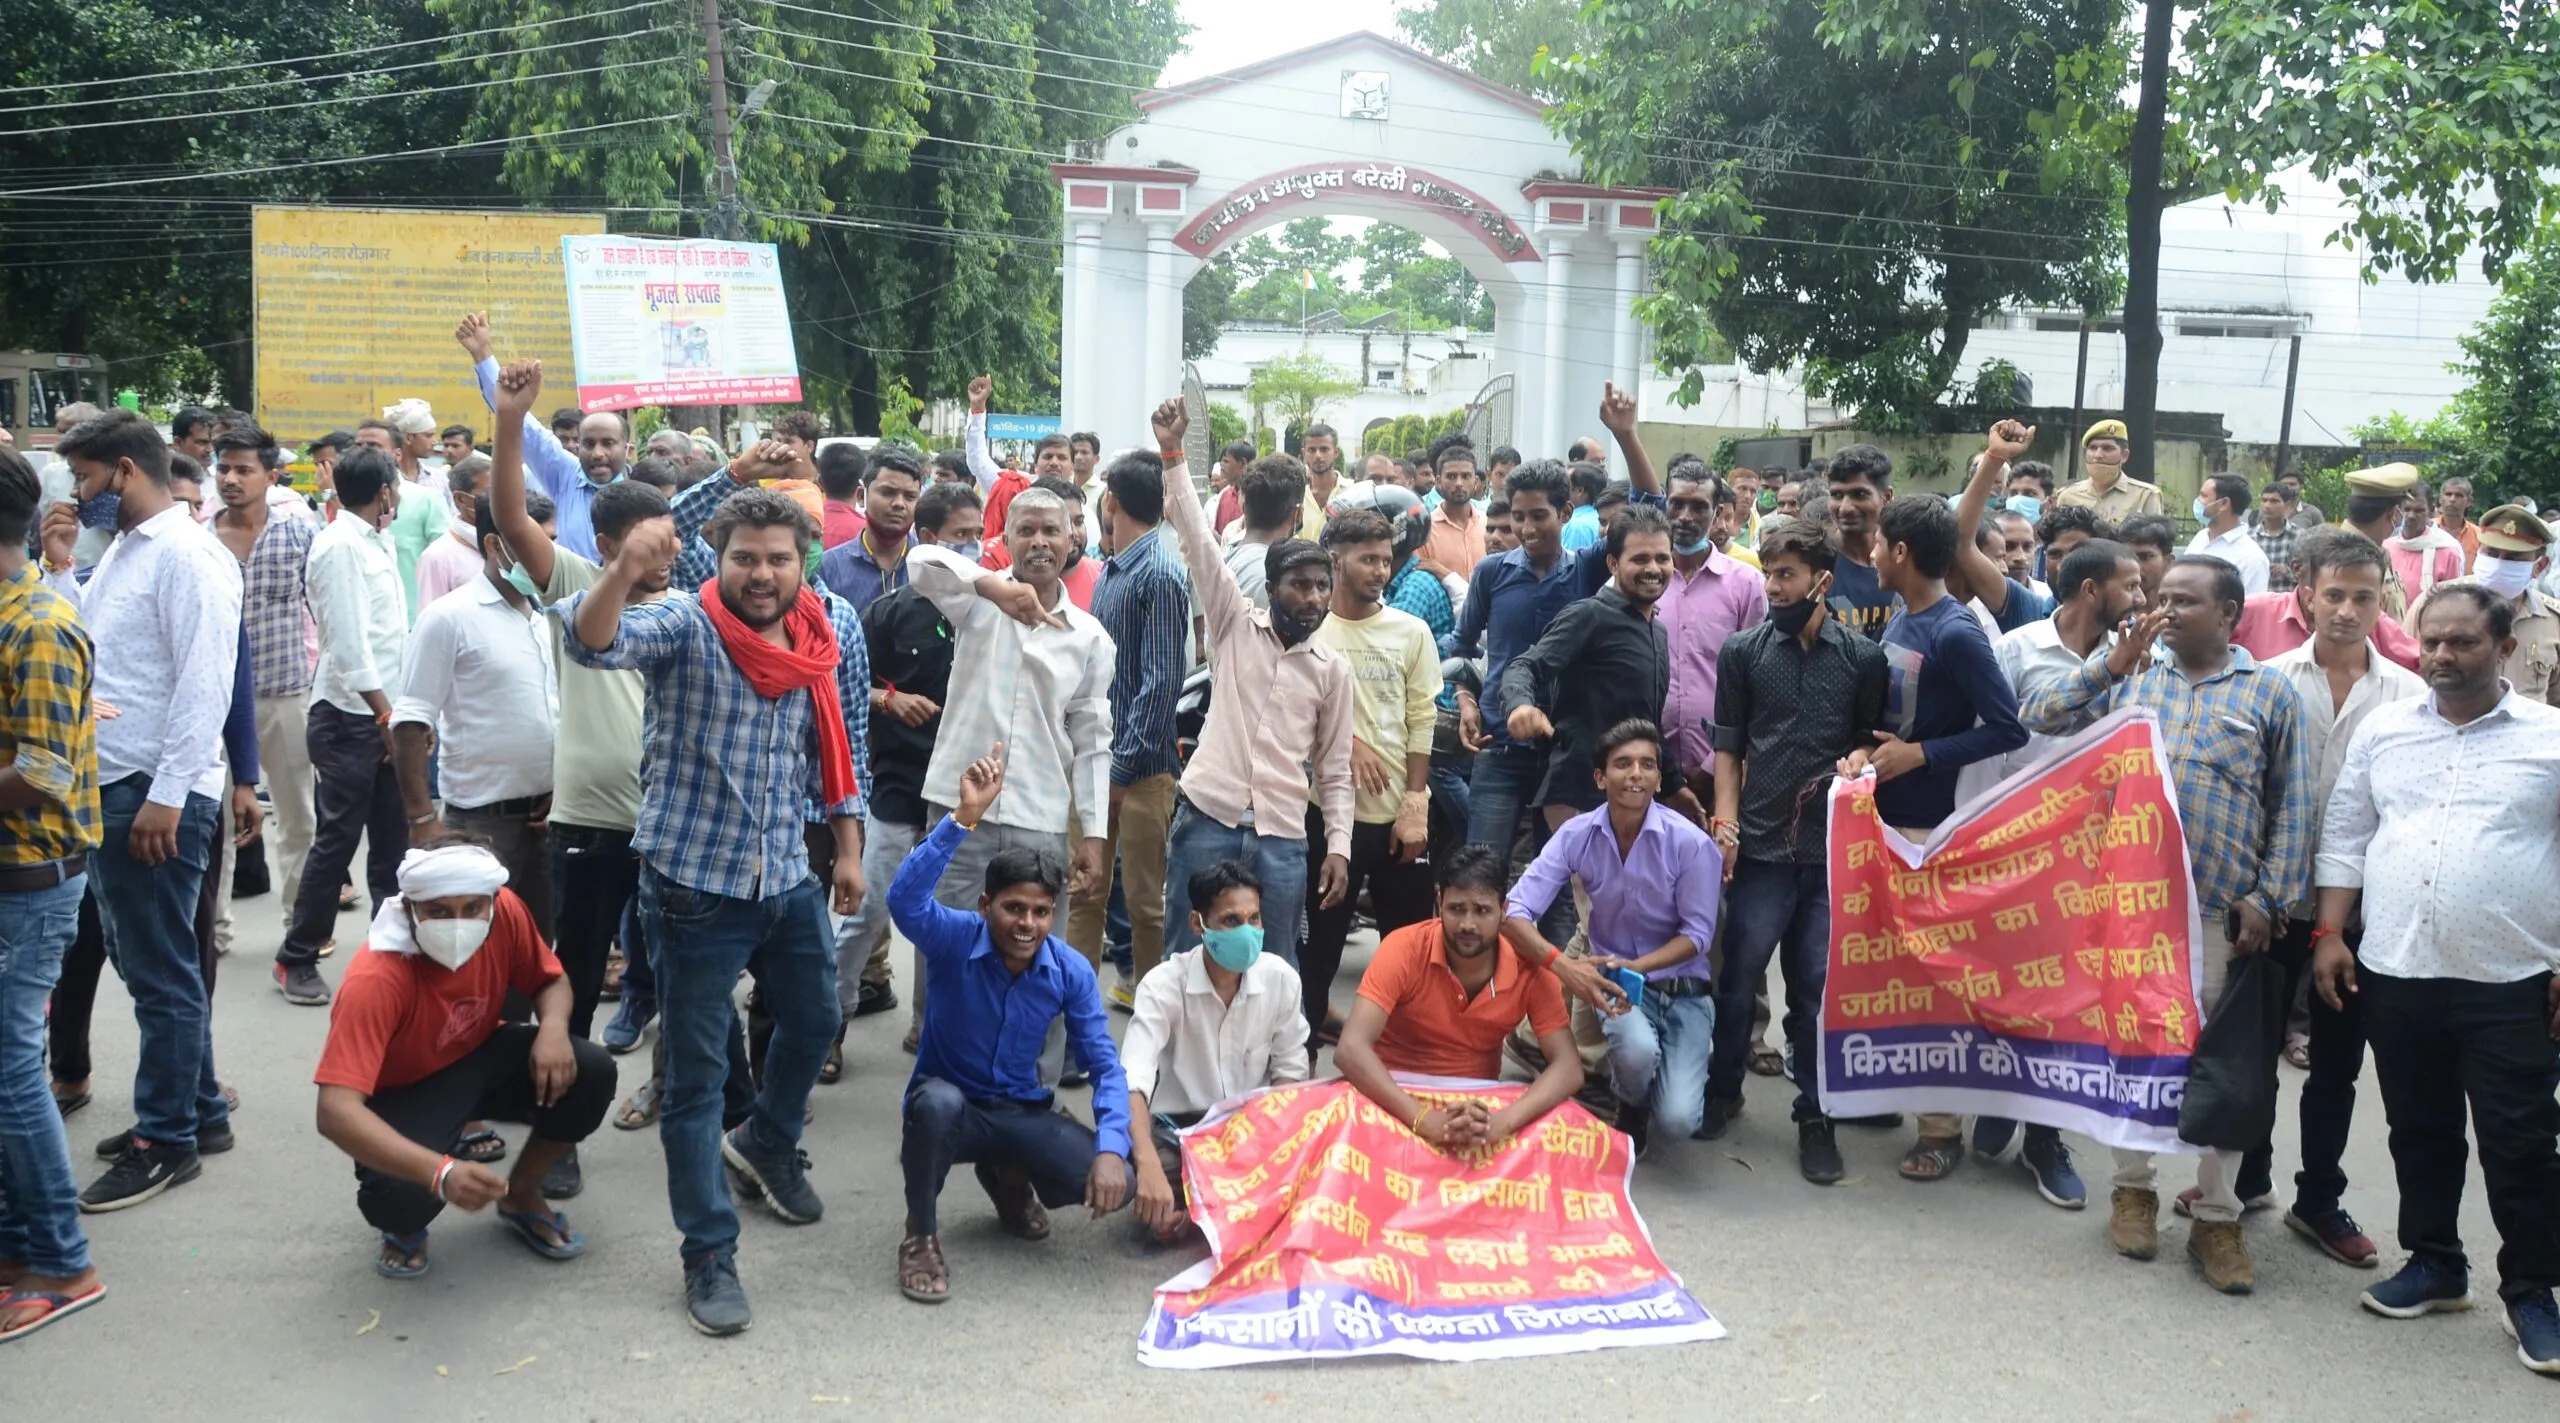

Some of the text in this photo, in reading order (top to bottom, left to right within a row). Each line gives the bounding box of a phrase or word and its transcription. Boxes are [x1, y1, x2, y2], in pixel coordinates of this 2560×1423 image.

[1273, 169, 1344, 199] आयुक्त
[1352, 164, 1407, 191] बरेली
[1842, 881, 1873, 916] के
[1992, 902, 2040, 932] का
[2114, 878, 2171, 917] द्वारा
[2013, 954, 2066, 988] यह
[2108, 931, 2177, 979] अपनी
[1839, 977, 1934, 1018] जमीन
[1841, 1029, 1974, 1078] किसानों
[1977, 1037, 2023, 1080] की
[2025, 1056, 2114, 1099] एकता
[1384, 1166, 1423, 1207] का
[1438, 1173, 1552, 1213] किसानों
[1561, 1187, 1619, 1221] द्वारा
[1380, 1227, 1430, 1257] यह
[1546, 1232, 1636, 1264] अपनी
[1555, 1265, 1606, 1291] की
[1174, 1289, 1327, 1344] किसानों
[1331, 1295, 1385, 1340] की
[1389, 1311, 1501, 1337] एकता
